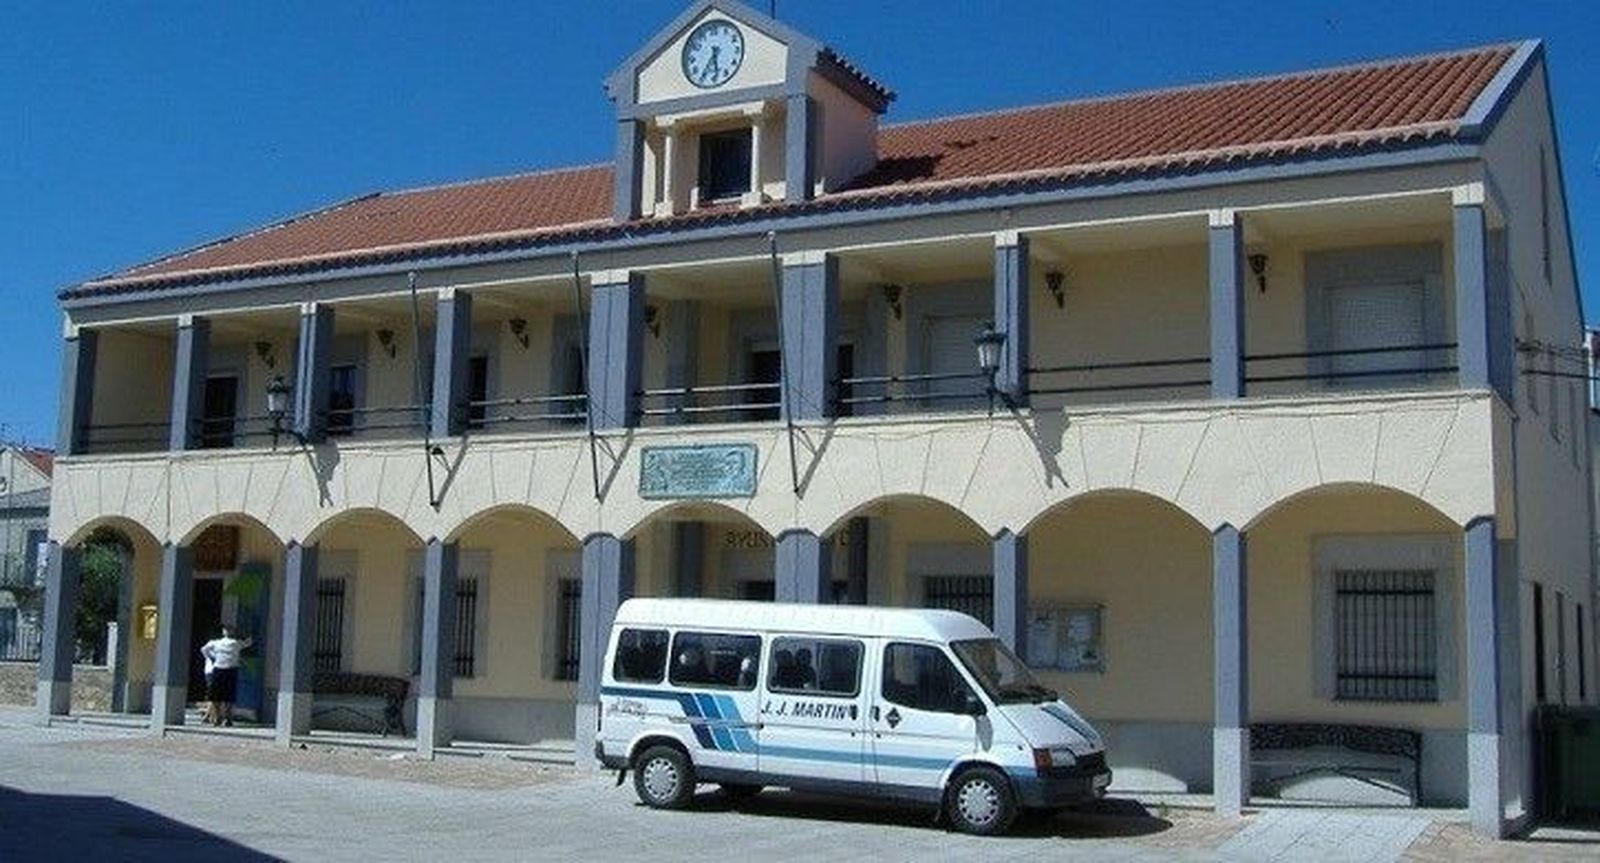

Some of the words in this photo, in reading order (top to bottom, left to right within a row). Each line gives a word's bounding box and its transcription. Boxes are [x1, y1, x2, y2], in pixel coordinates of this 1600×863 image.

[761, 701, 772, 714] J.
[776, 702, 788, 715] J.
[793, 702, 847, 719] MARTIN
